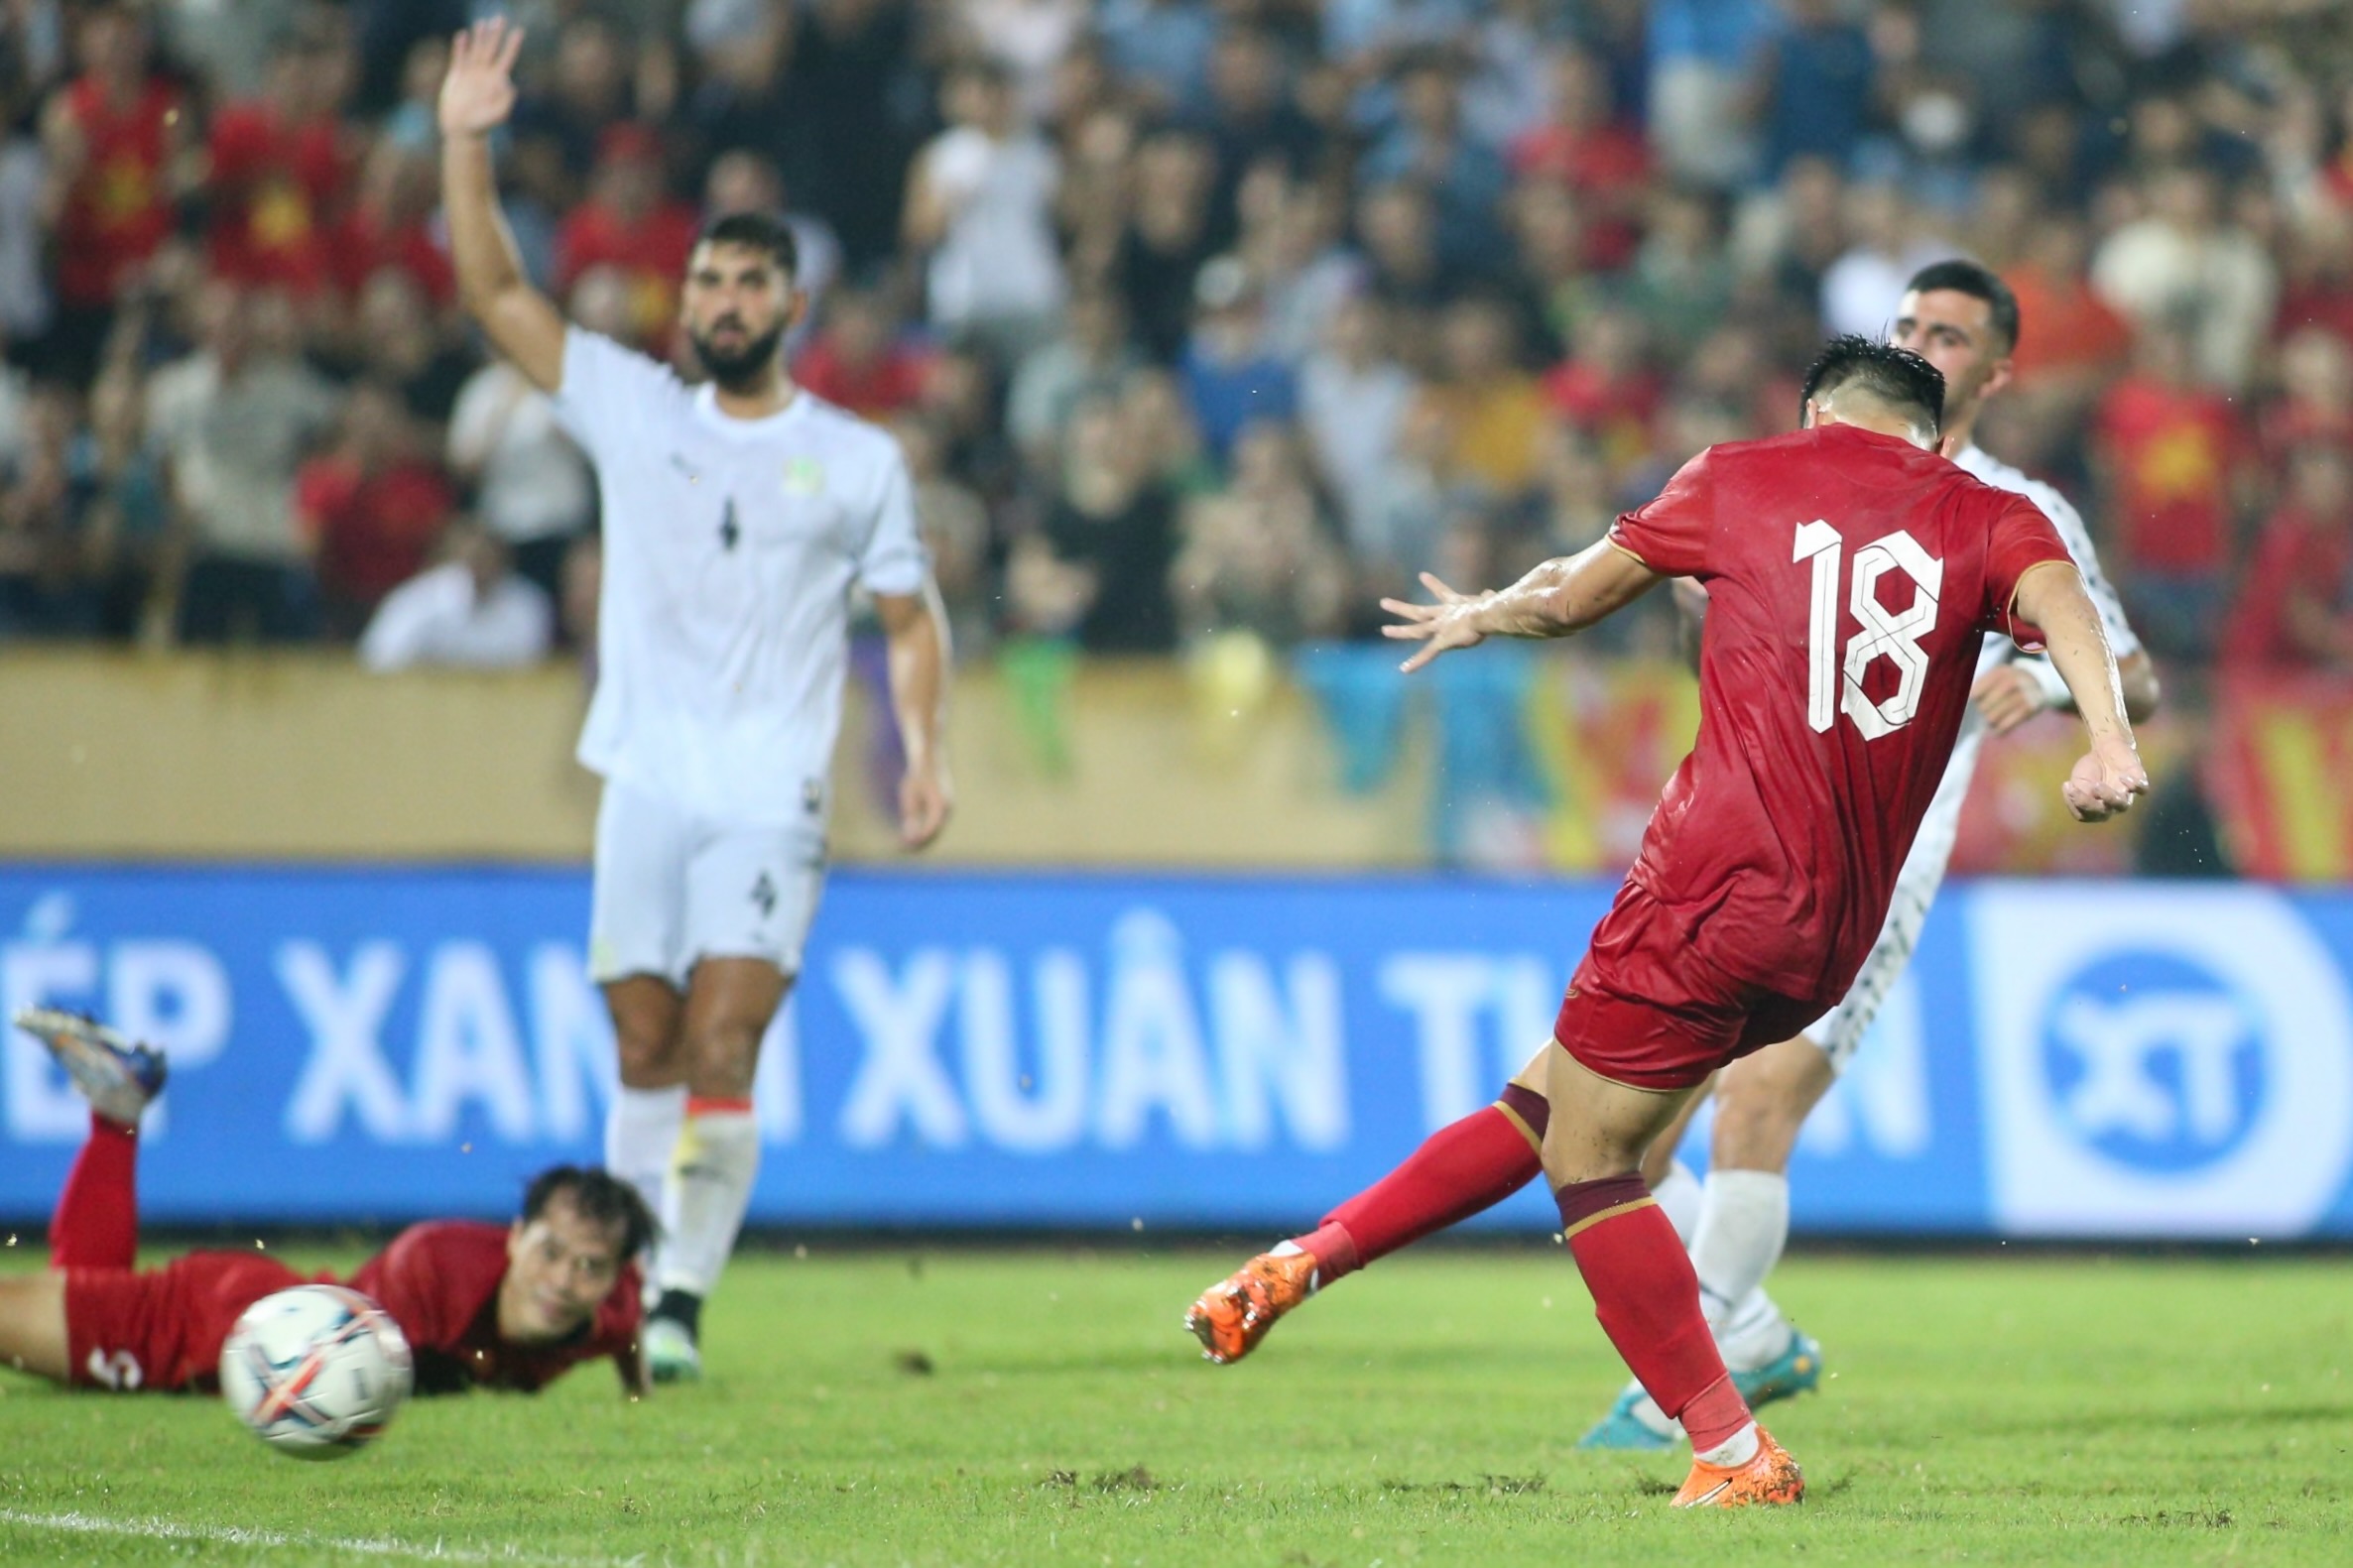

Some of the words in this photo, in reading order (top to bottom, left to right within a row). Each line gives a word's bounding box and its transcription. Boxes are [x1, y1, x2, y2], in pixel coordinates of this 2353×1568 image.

[1793, 519, 1943, 741] 18
[749, 870, 777, 918] 4
[831, 908, 1349, 1151] XUÂN
[2055, 992, 2255, 1144] XT
